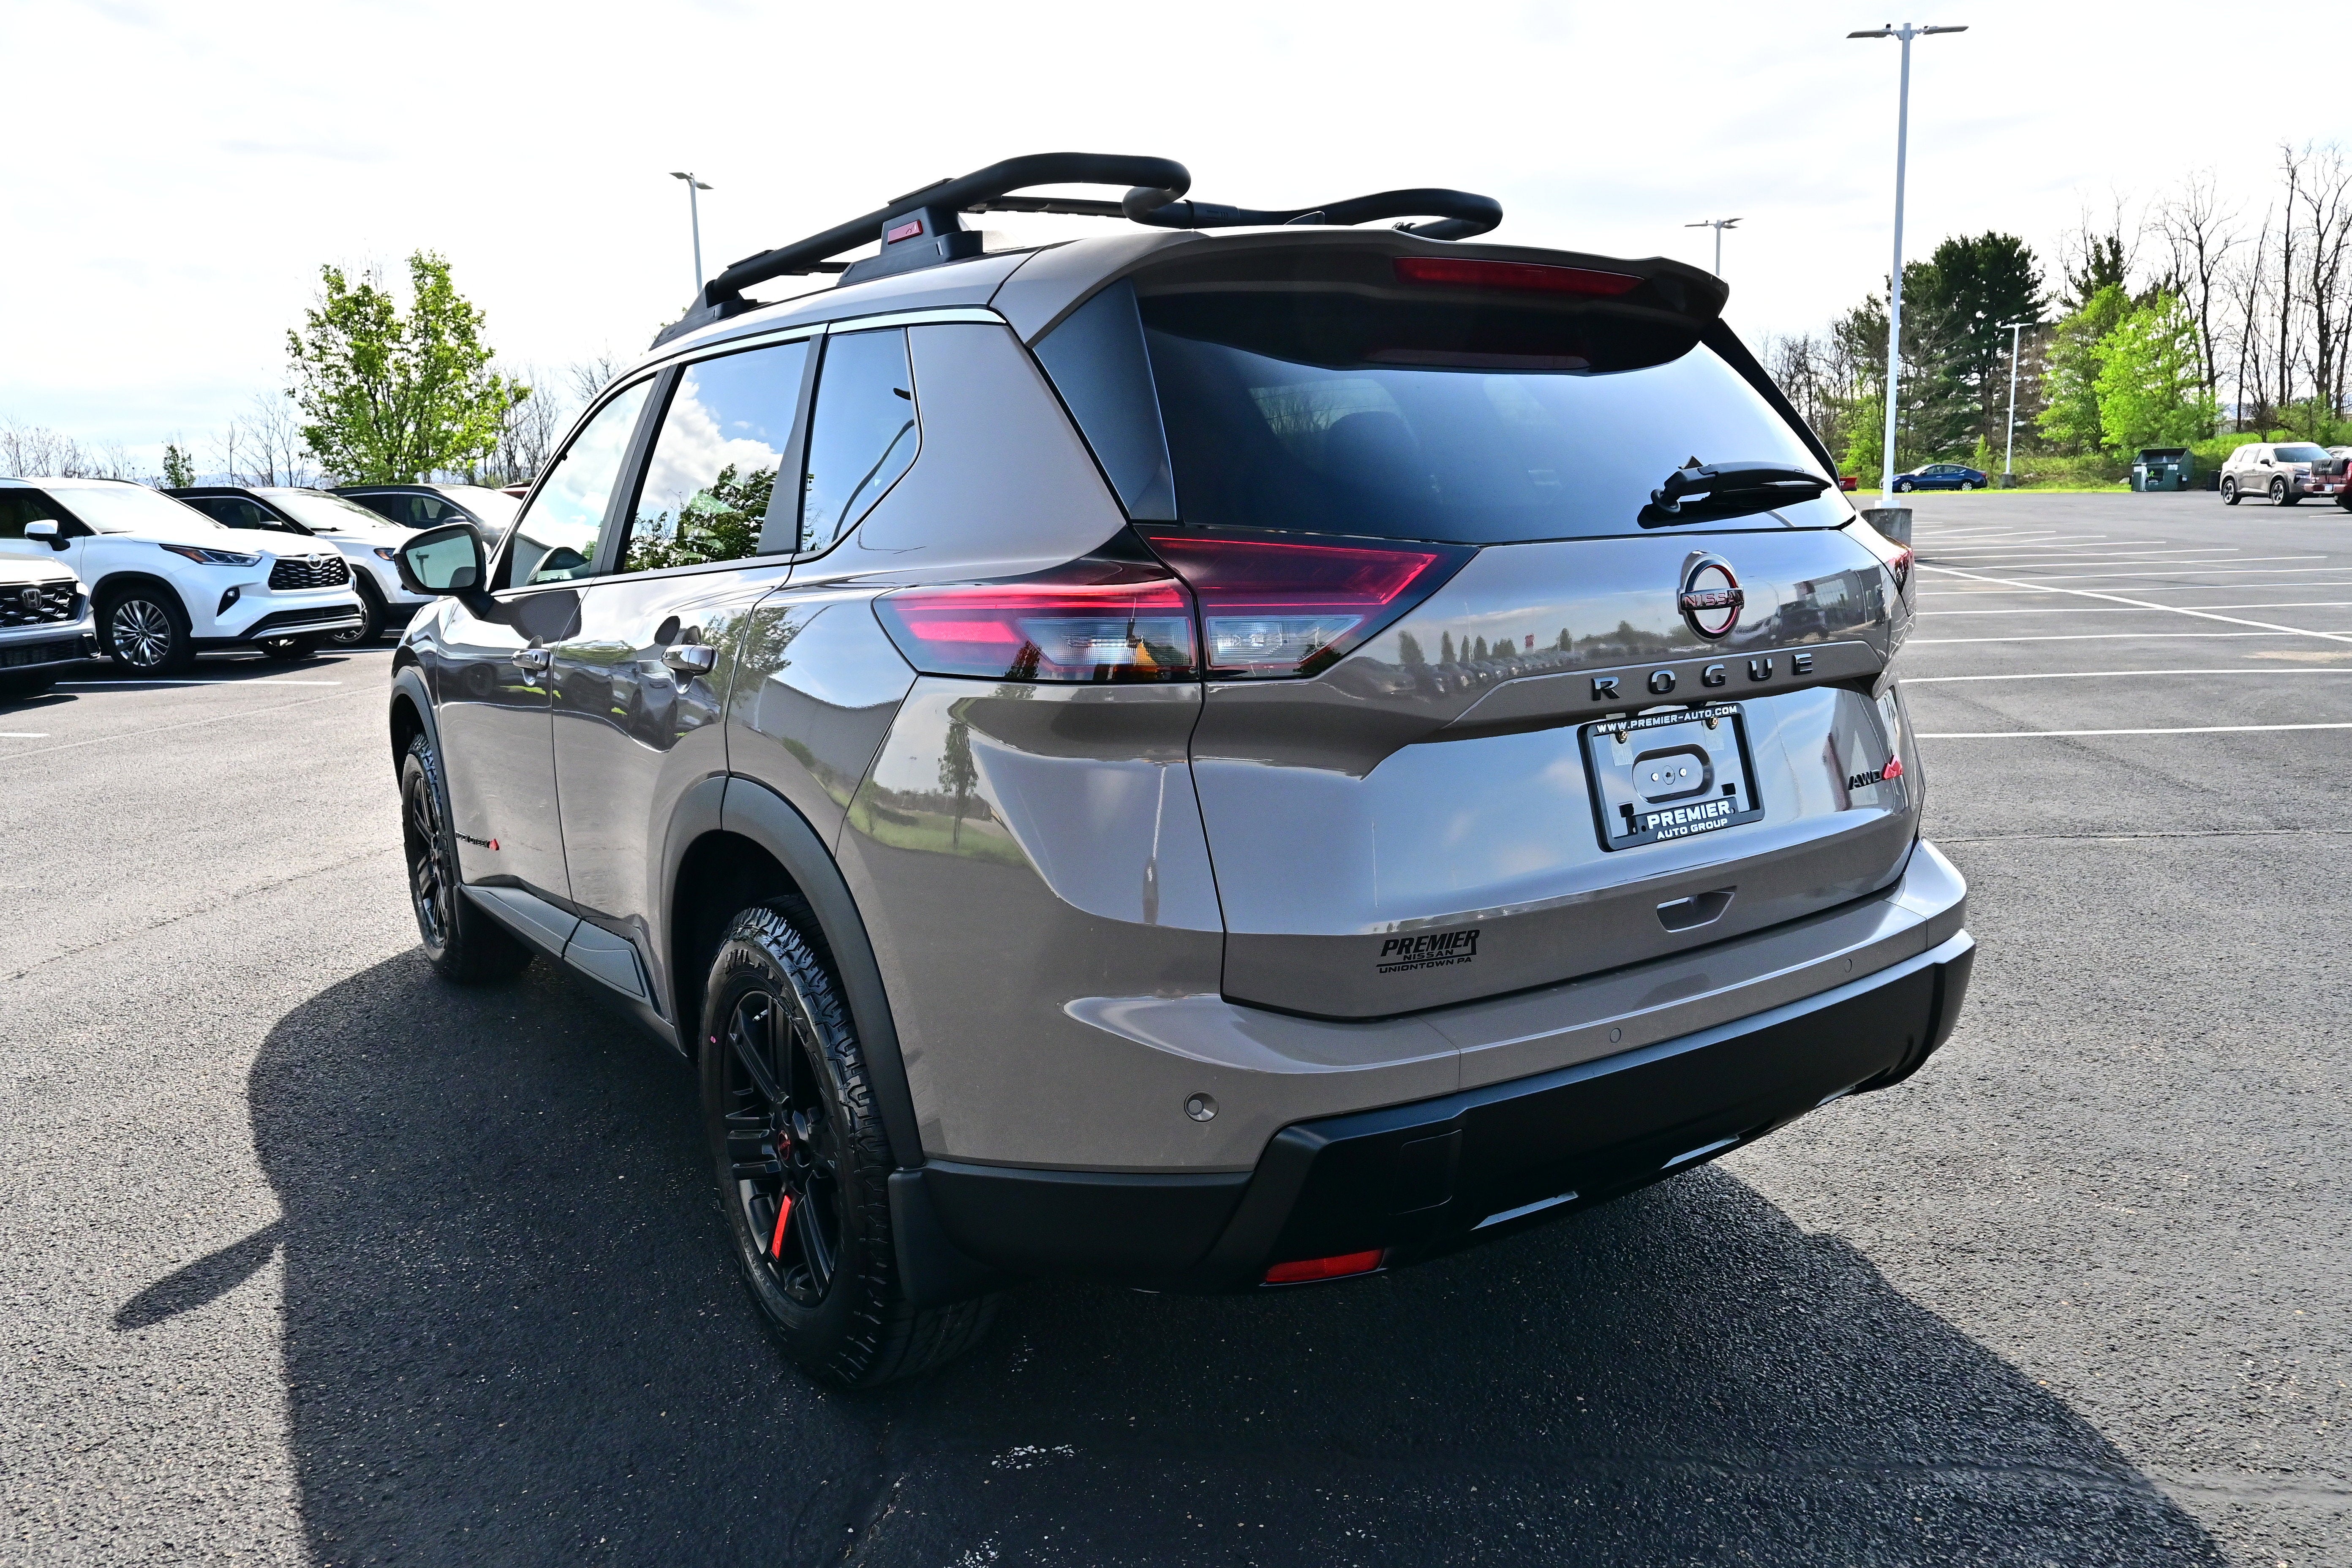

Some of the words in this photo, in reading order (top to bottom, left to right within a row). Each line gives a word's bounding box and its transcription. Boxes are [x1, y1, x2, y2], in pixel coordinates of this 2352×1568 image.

[1684, 591, 1744, 607] NISSAN
[1591, 653, 1813, 701] ROGUE
[1597, 705, 1737, 733] WWW.PREMIER-AUTO.COM
[1848, 769, 1881, 790] AWD
[1647, 800, 1731, 830] PREMIER
[1657, 826, 1688, 840] AUTO
[1690, 818, 1728, 833] GROUP
[1380, 929, 1480, 956] PREMIER
[1379, 959, 1454, 973] UNIONTOWN
[1403, 949, 1454, 961] NISSAN
